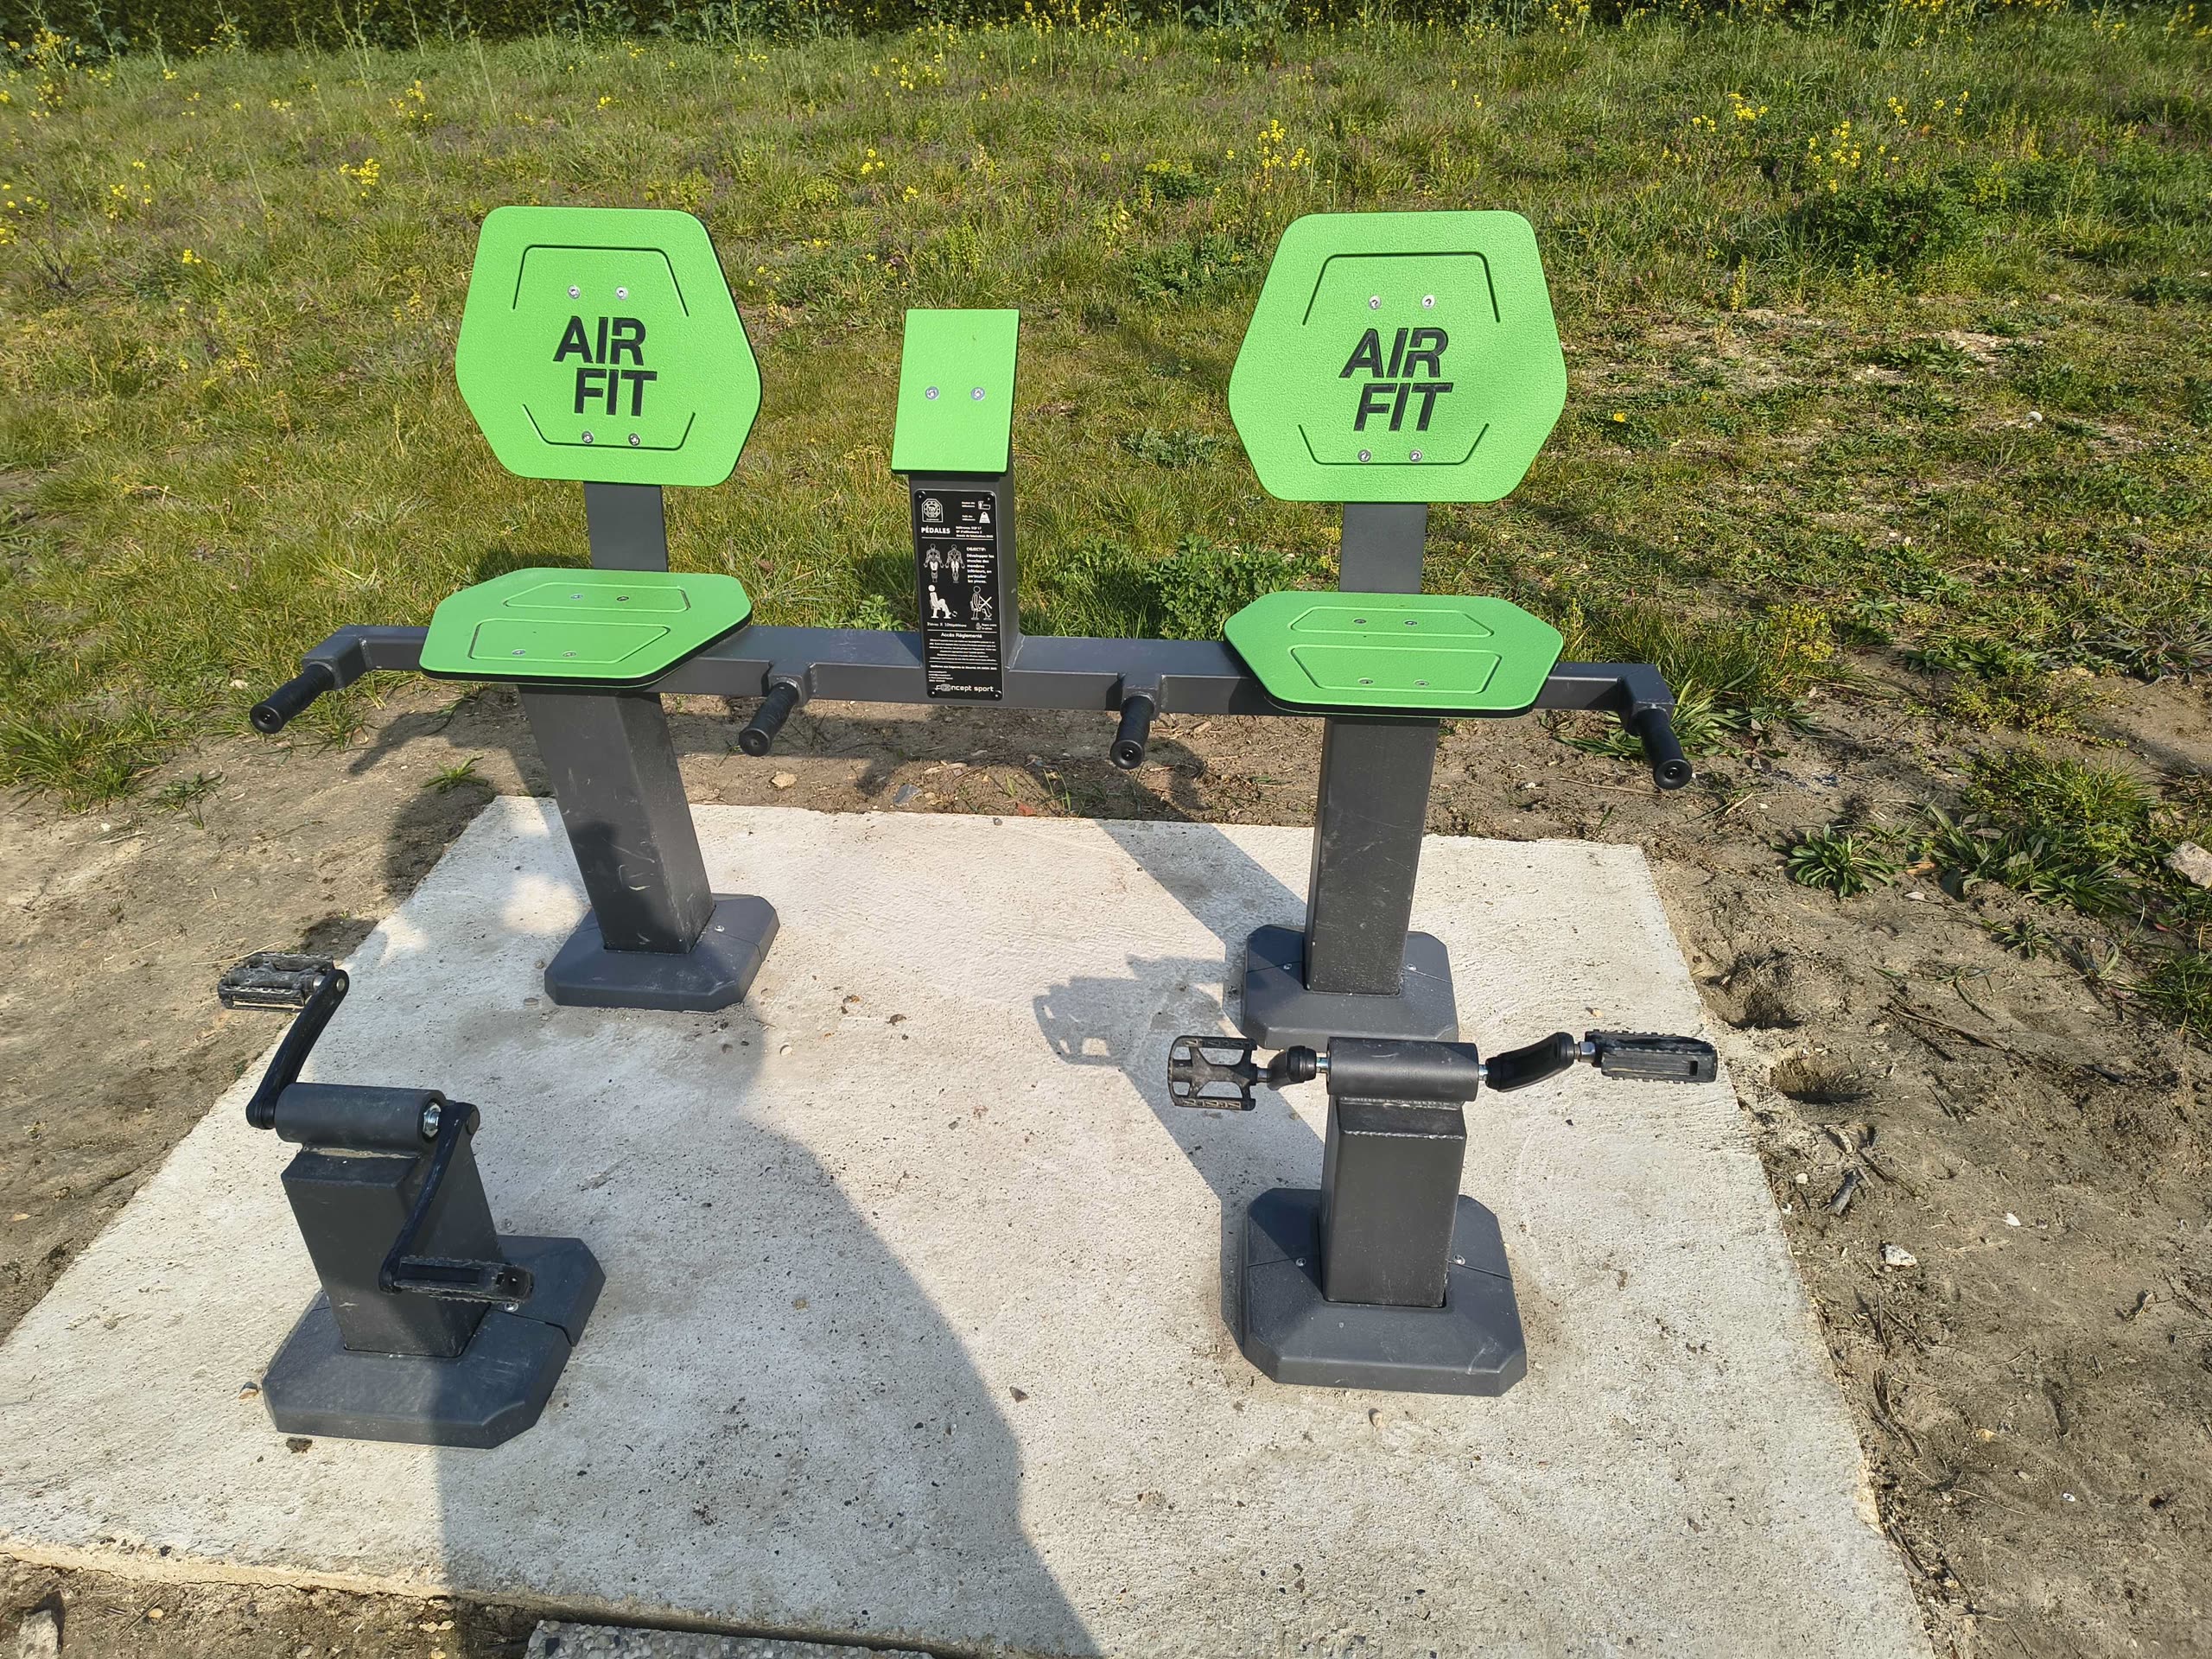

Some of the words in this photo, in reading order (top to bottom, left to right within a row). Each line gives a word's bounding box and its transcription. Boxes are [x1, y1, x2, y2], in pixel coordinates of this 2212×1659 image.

[553, 315, 646, 365] AIR
[1338, 327, 1449, 378] AIR
[574, 367, 658, 416] FIT
[1353, 383, 1453, 431] FIT
[921, 525, 950, 534] PÉDALES
